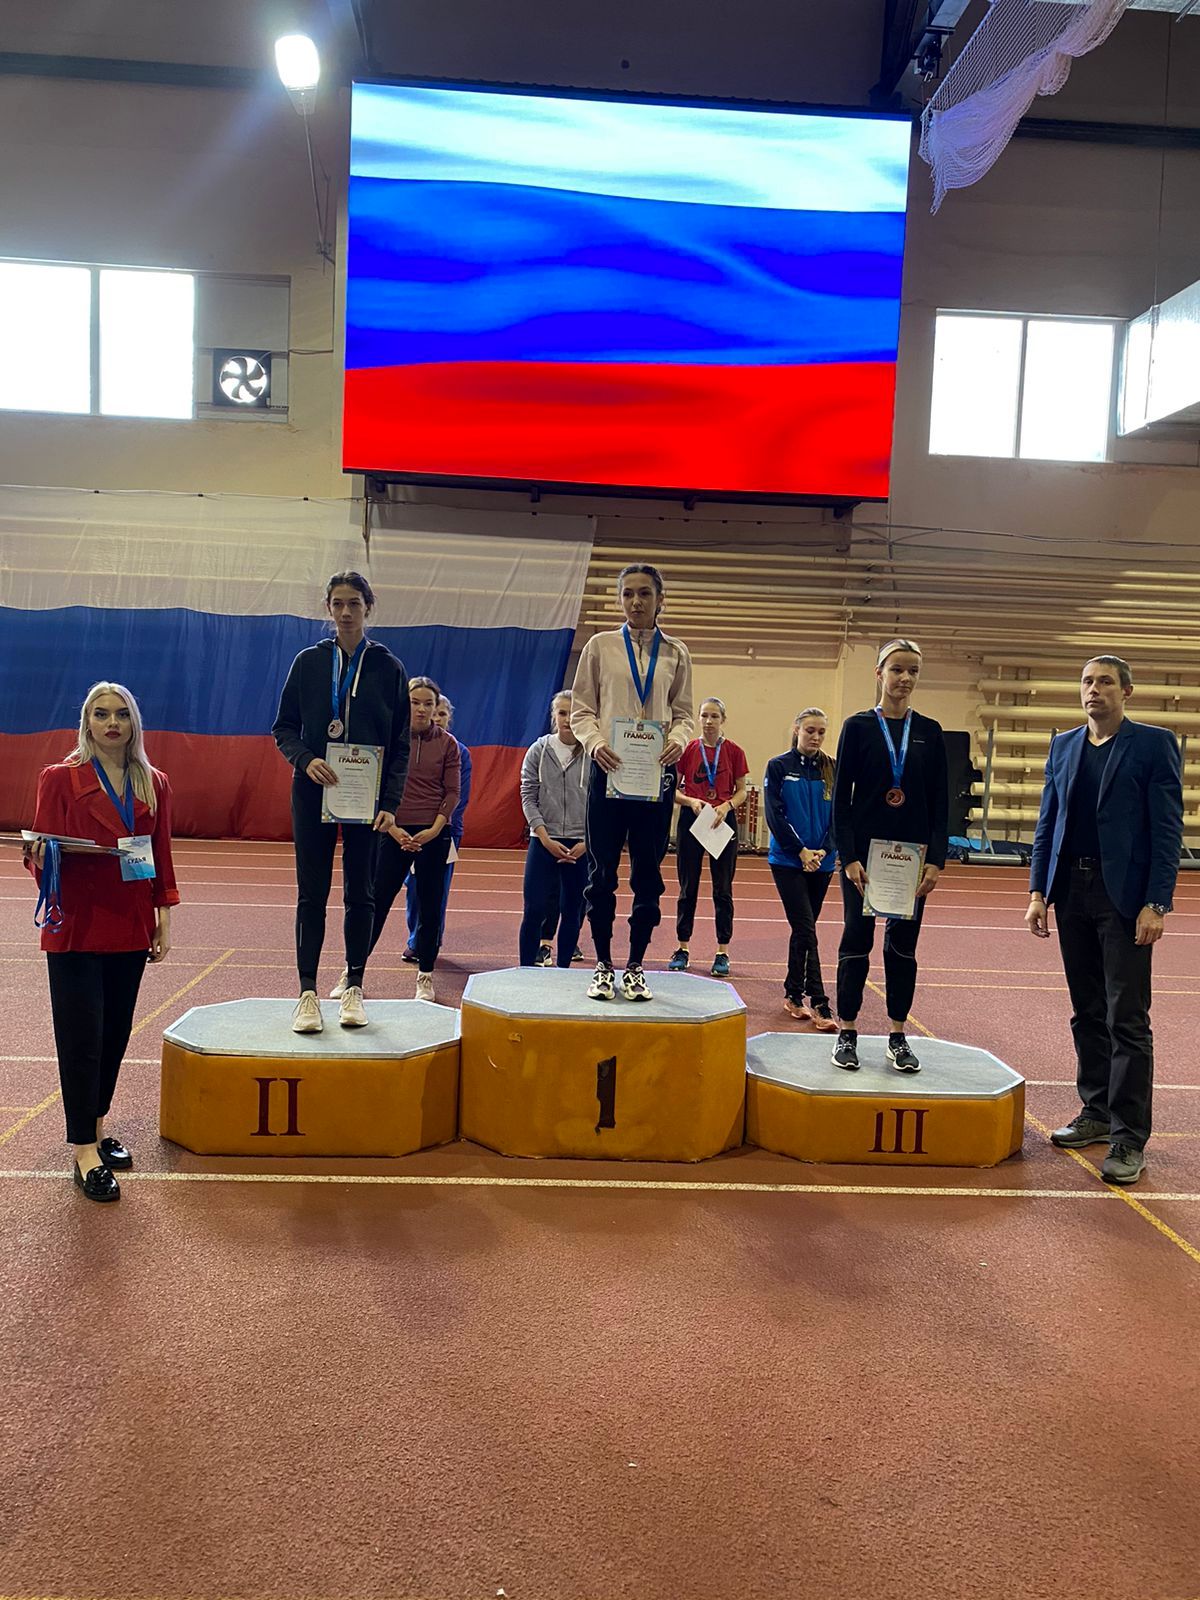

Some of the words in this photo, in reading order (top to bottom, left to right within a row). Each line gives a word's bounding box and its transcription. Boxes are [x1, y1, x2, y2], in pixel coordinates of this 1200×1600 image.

[623, 732, 655, 740] ГРАМОТА
[338, 757, 370, 765] ГРАМОТА
[880, 852, 912, 862] ГРАМОТА
[250, 1077, 306, 1137] II
[867, 1107, 930, 1155] III
